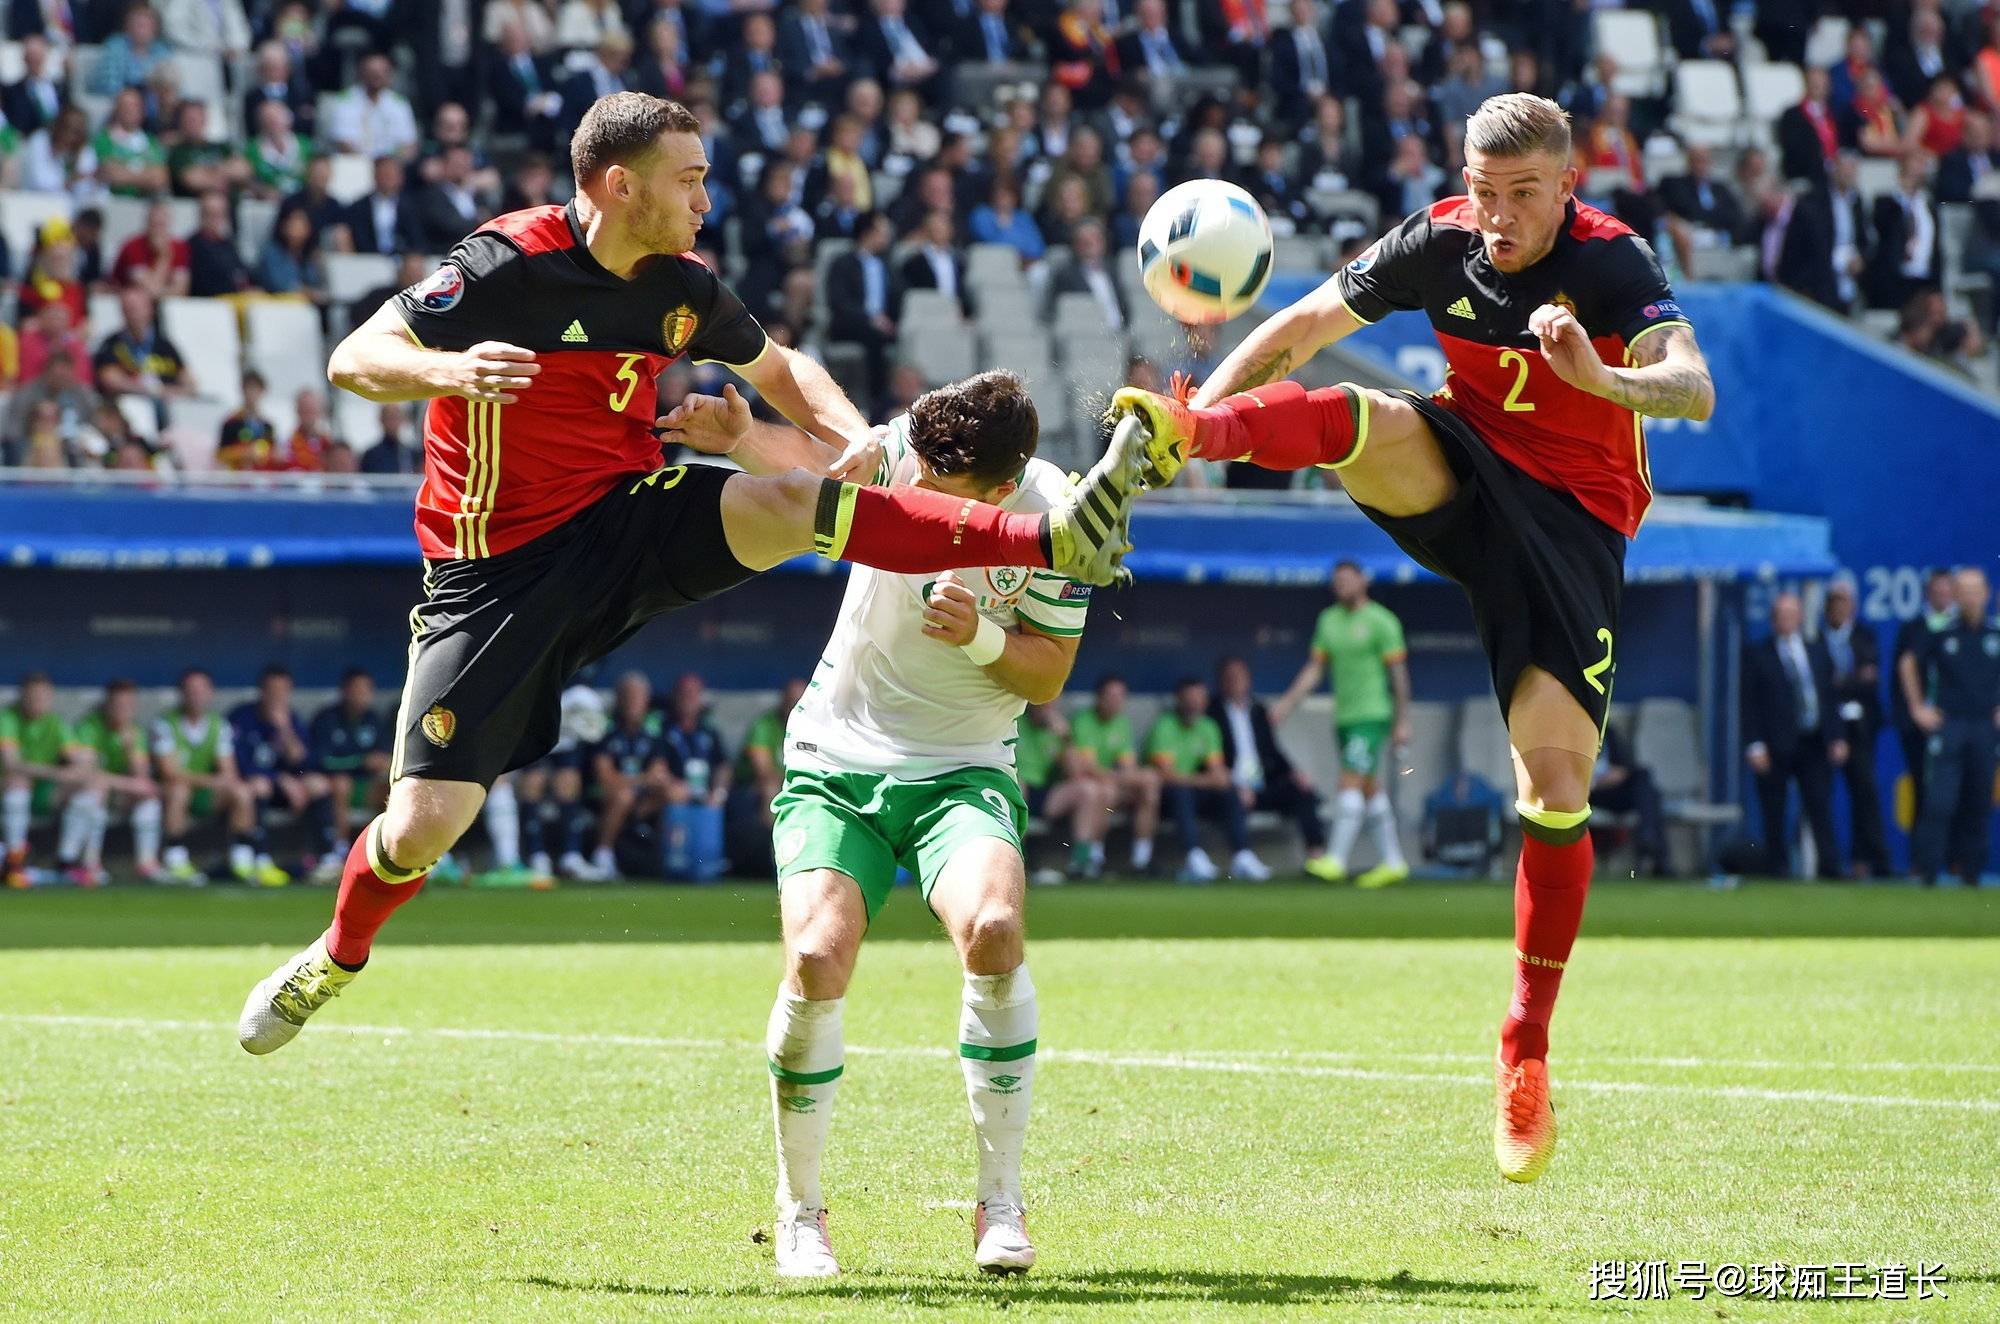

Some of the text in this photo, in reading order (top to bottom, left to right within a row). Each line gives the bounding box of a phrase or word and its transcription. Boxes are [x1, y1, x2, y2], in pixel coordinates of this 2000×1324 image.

[561, 334, 589, 343] adidas
[1446, 307, 1477, 320] adidas
[608, 352, 646, 413] 3
[1499, 351, 1536, 412] 2
[1583, 627, 1613, 695] 2
